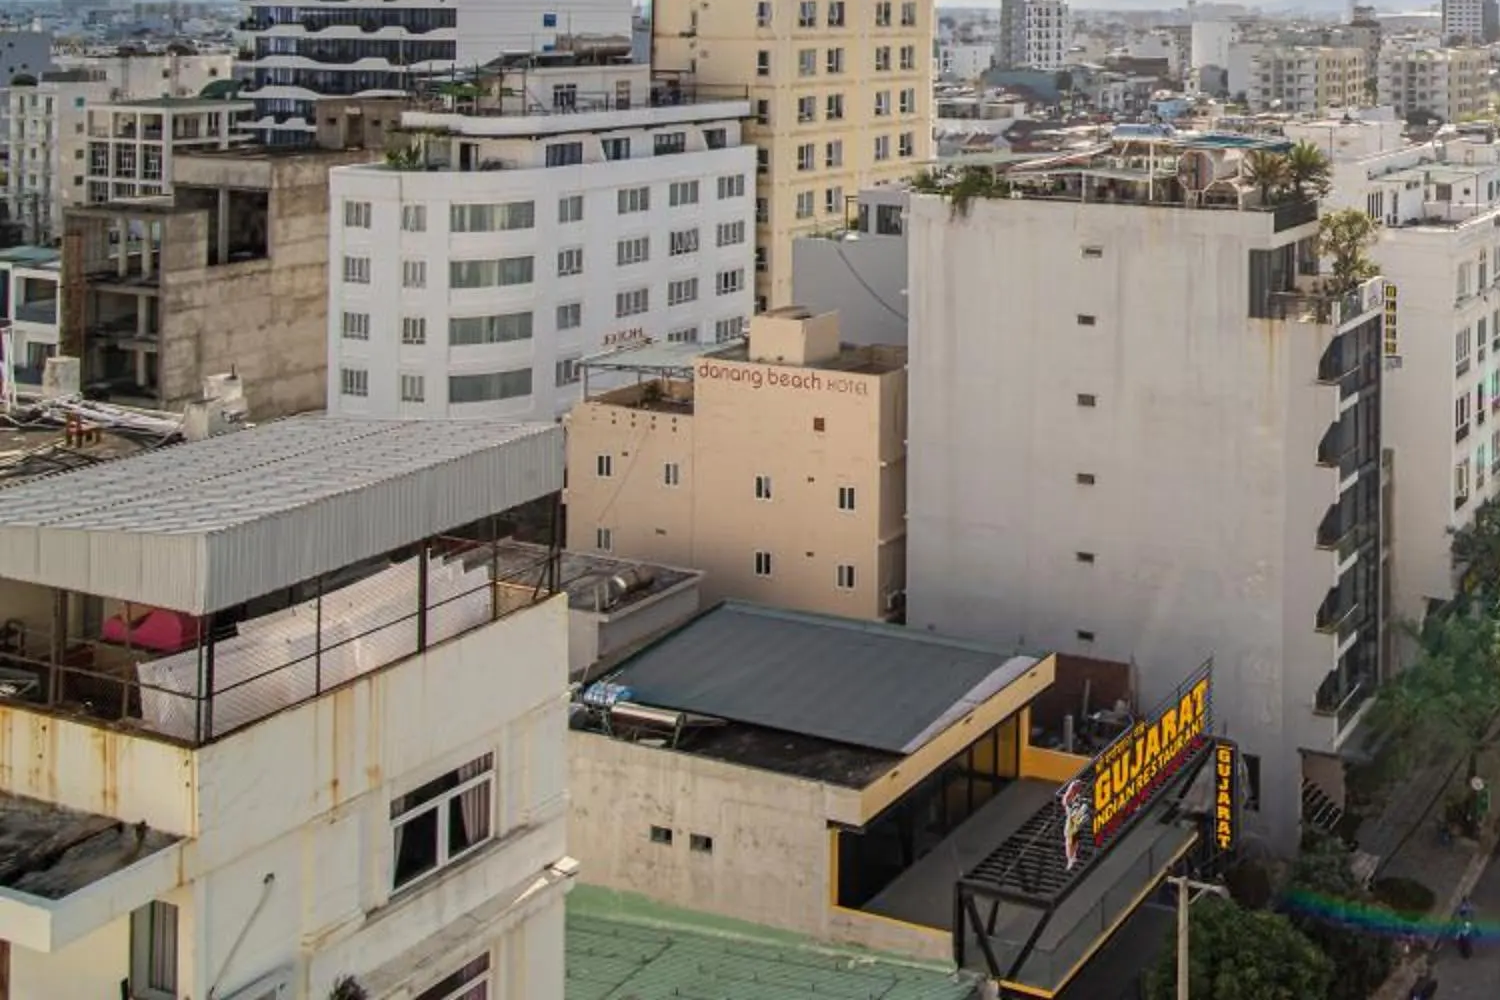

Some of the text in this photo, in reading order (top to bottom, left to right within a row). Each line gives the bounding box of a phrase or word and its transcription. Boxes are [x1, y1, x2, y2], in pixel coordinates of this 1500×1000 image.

[699, 361, 868, 395] danang beach HOTEL
[1095, 679, 1209, 811] GUJARAT
[1217, 750, 1231, 849] GUJARAT
